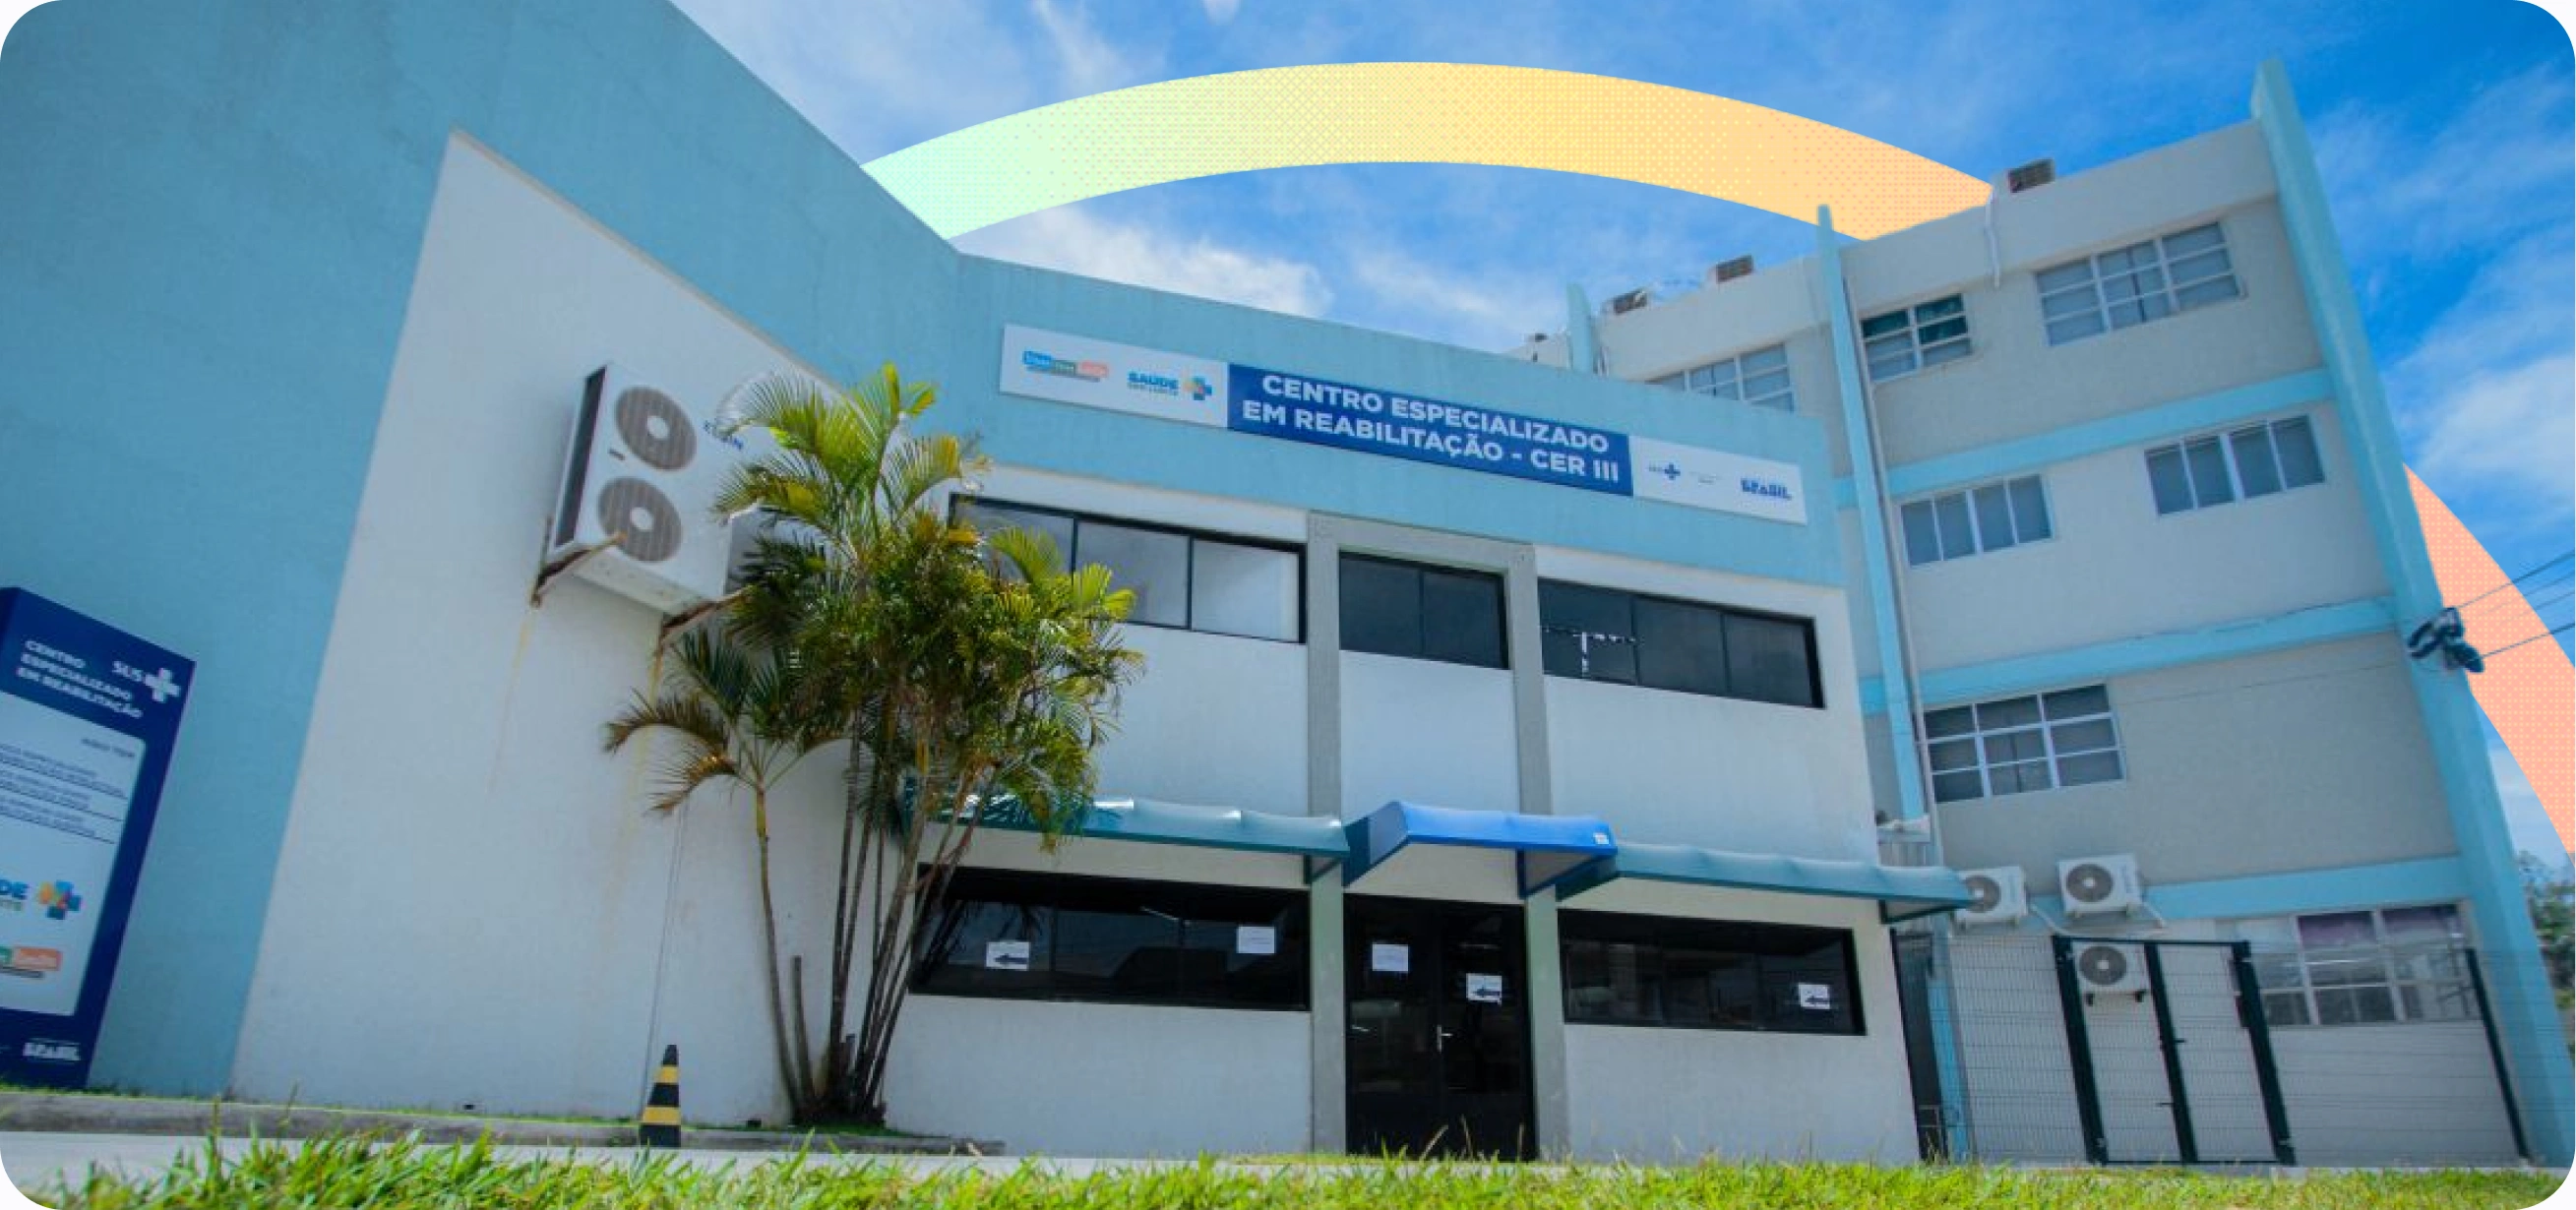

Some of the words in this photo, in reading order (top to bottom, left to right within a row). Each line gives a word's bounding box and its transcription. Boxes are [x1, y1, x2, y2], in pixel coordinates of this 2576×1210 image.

[1261, 375, 1383, 413] CENTRO
[1390, 397, 1609, 454] ESPECIALIZADO
[1242, 399, 1286, 426] EM
[1294, 408, 1503, 462] REABILITAÇÃO
[1529, 449, 1586, 477] CER
[1592, 459, 1619, 483] III
[21, 652, 133, 700] ESPECIALIZADO
[25, 639, 86, 669] CENTRO
[112, 660, 145, 683] SUS
[17, 666, 40, 683] EM
[41, 674, 144, 718] REABILITAÇÃO
